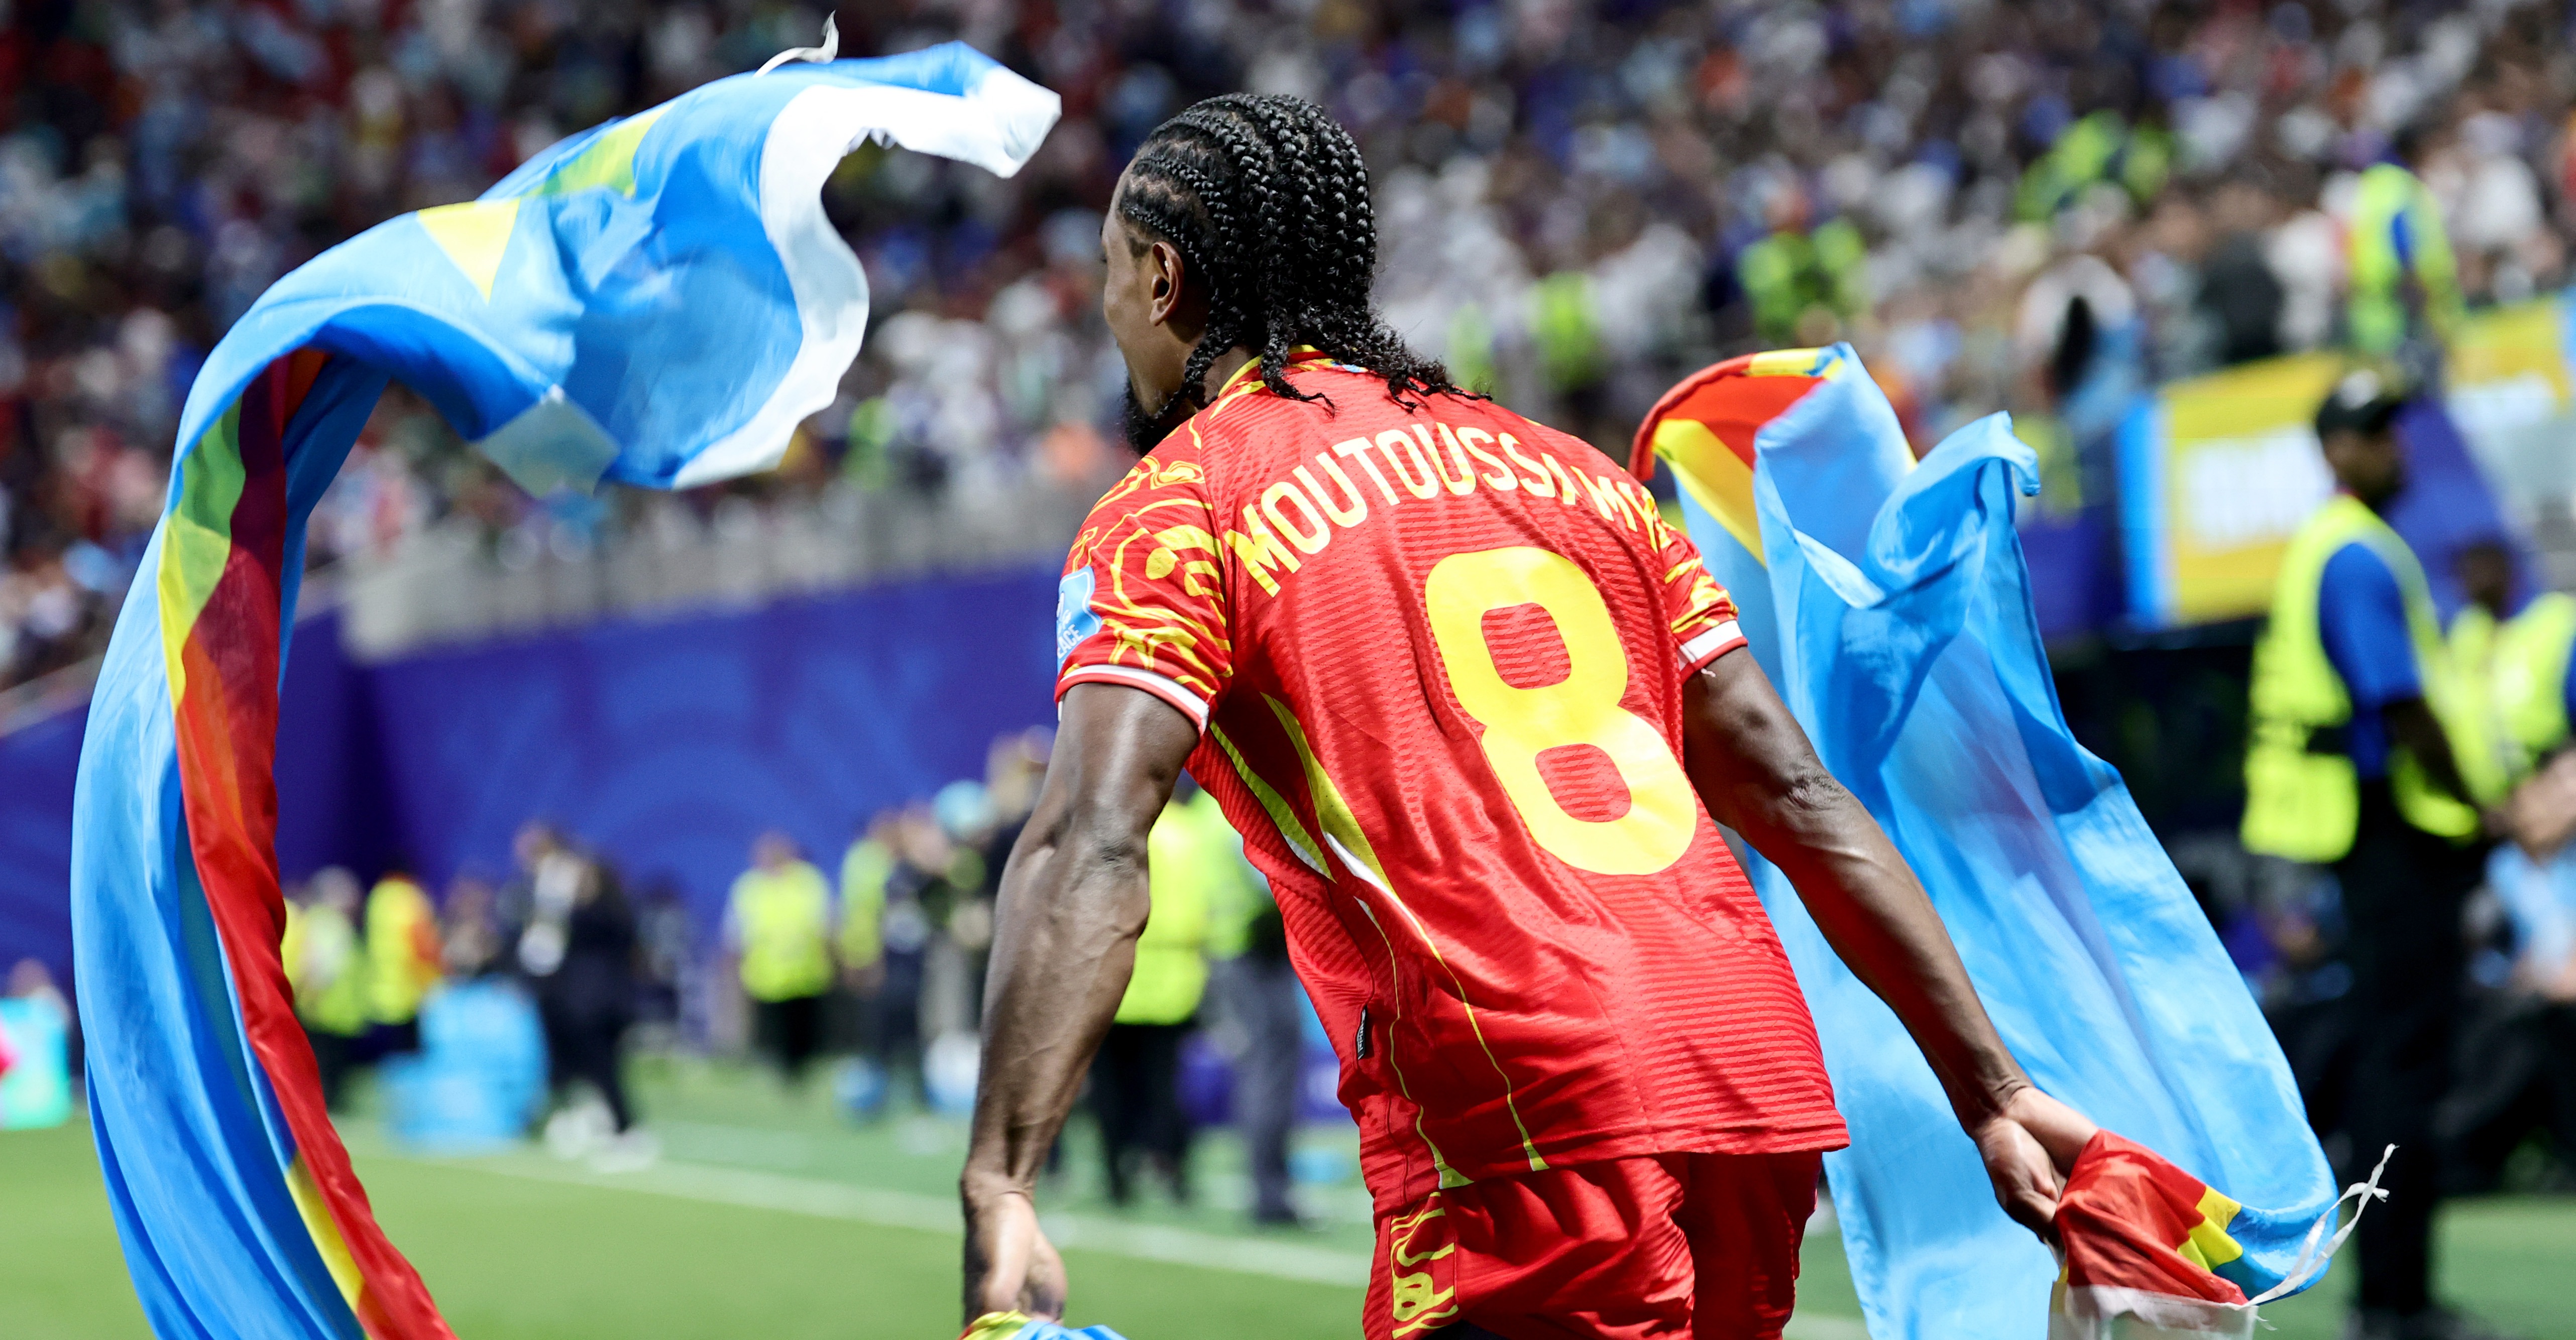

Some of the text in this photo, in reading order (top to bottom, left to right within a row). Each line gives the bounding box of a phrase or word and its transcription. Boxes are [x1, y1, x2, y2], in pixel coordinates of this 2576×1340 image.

[1224, 422, 1658, 597] MOUTOUSSAMY
[1057, 624, 1084, 659] EACE
[1425, 546, 1698, 876] 8
